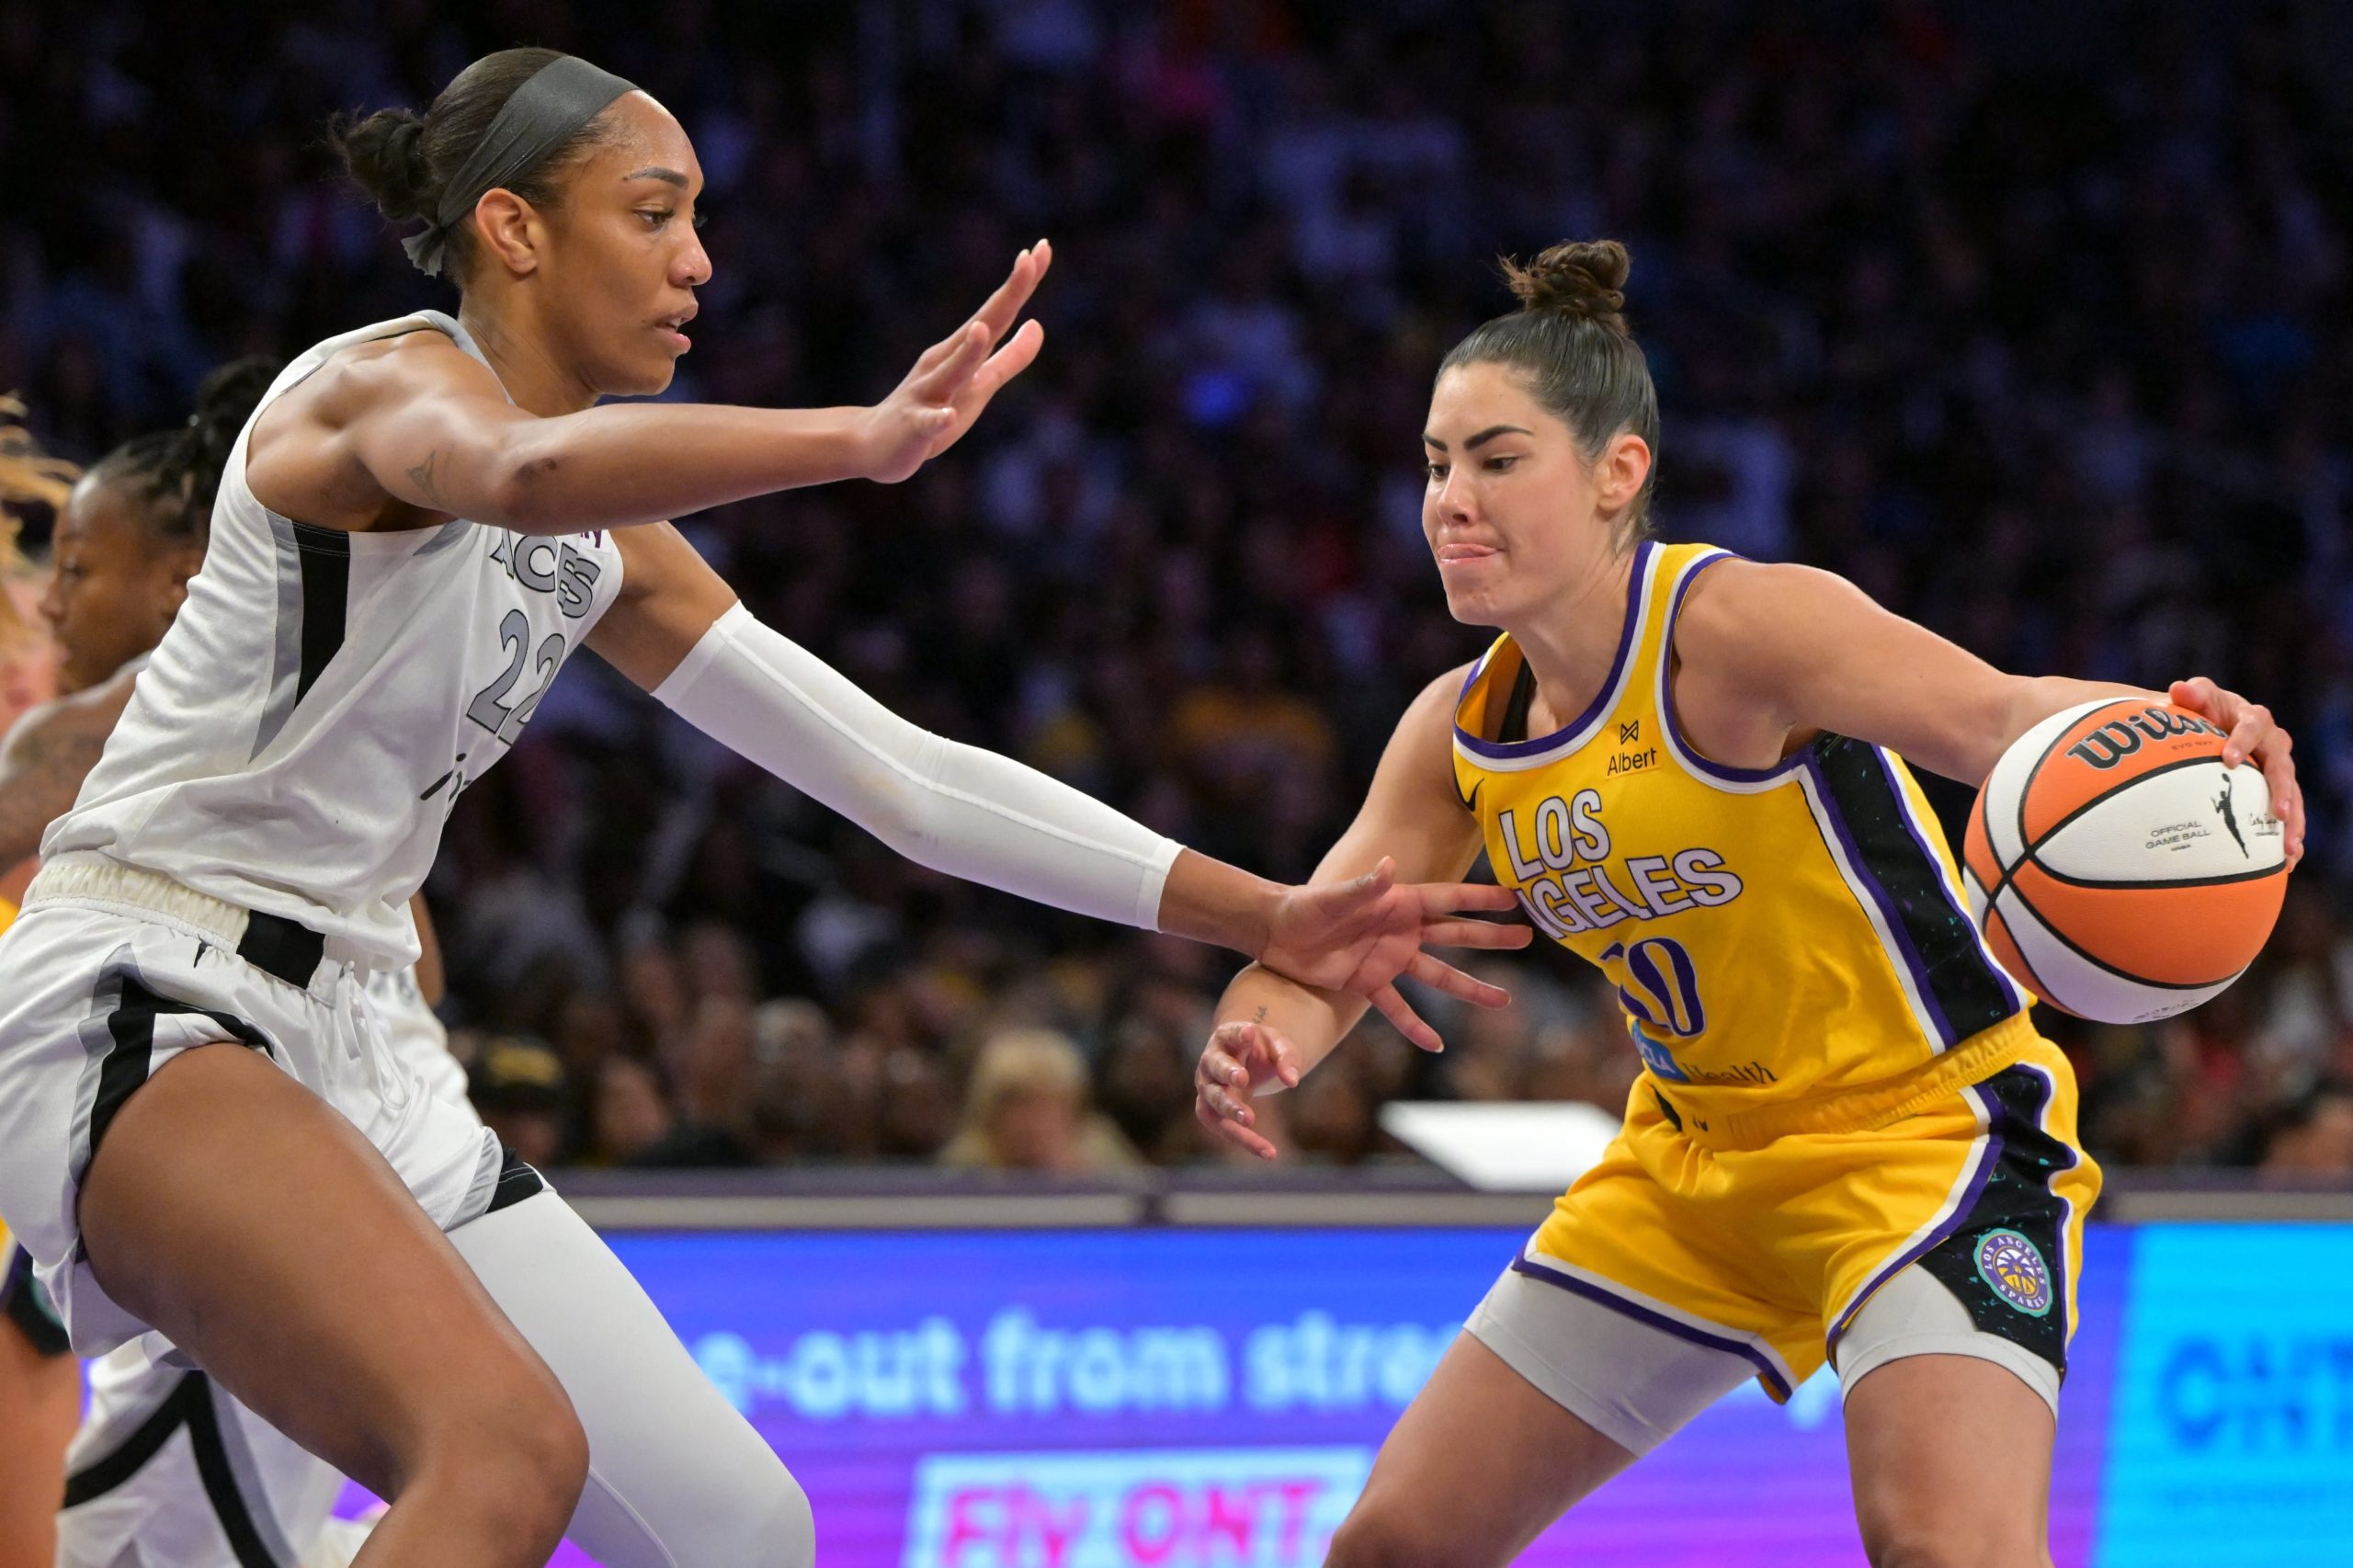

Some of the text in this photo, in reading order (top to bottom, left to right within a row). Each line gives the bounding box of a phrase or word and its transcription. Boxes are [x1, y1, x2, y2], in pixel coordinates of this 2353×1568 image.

[490, 528, 602, 619] ACES
[465, 608, 566, 746] 22
[1607, 746, 1657, 777] Albert
[1498, 789, 1610, 883] LOS
[2145, 835, 2181, 849] GAME
[2182, 828, 2211, 841] BALL
[2151, 821, 2202, 837] OFFICIAL
[1983, 1244, 1995, 1271] LOS
[1996, 1235, 2047, 1286] ANGELES
[1999, 1283, 2045, 1308] SPARKS
[984, 1307, 1228, 1414] from
[1245, 1312, 1471, 1412] stre
